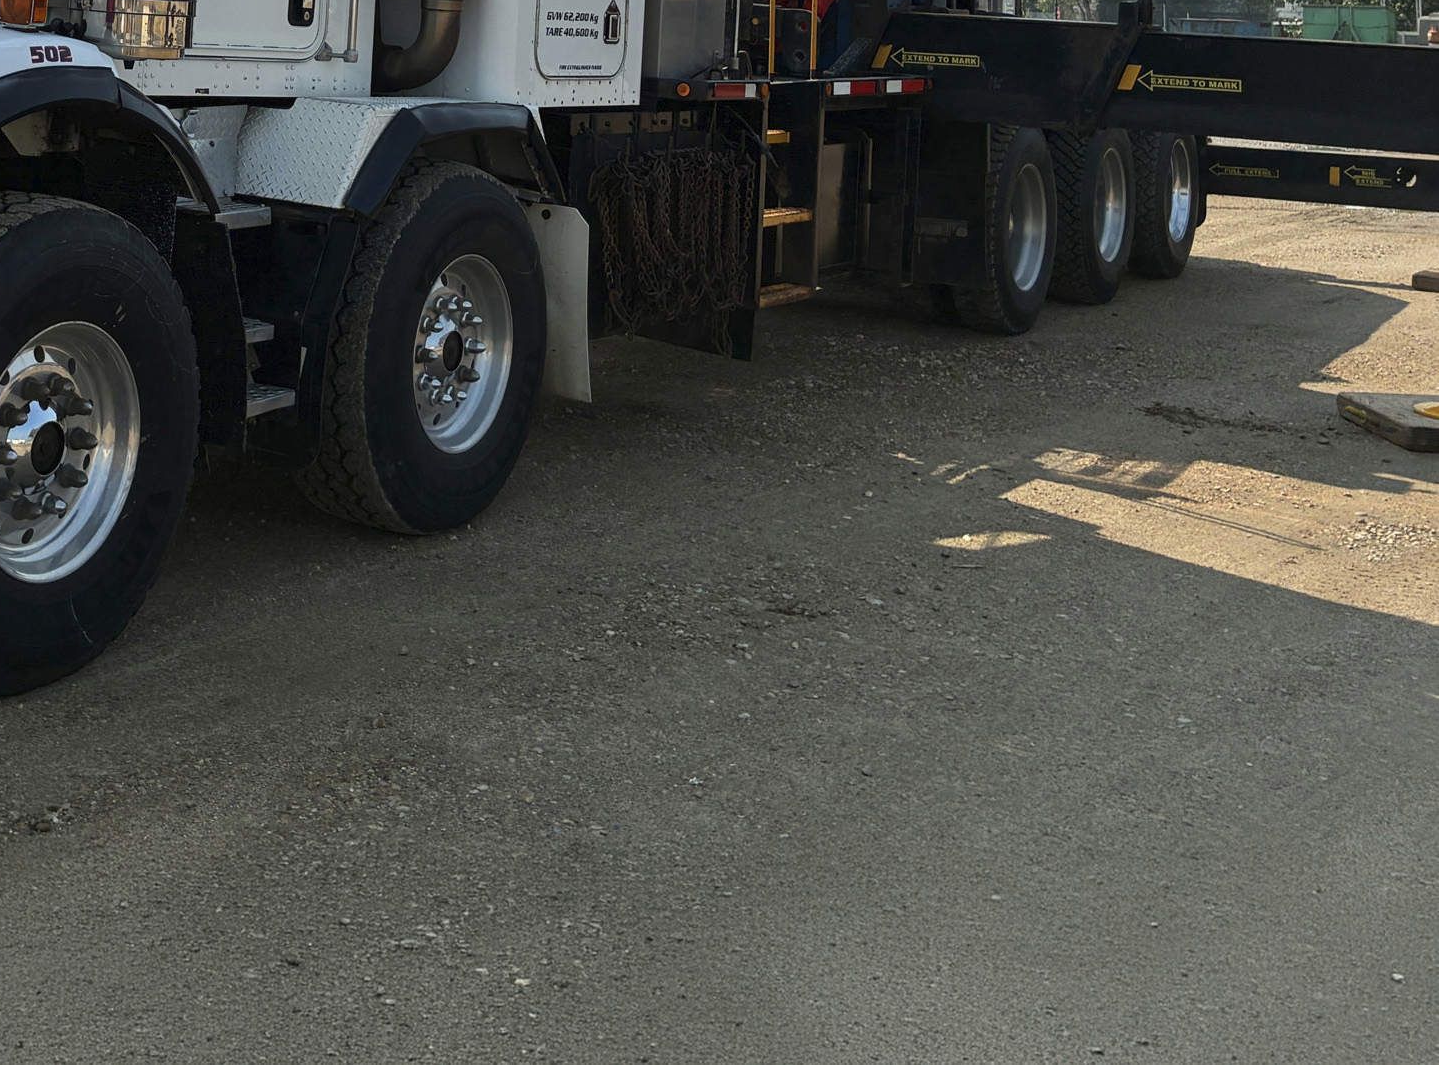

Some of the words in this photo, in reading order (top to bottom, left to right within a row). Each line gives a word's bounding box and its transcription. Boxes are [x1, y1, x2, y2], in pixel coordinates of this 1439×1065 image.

[546, 11, 563, 21] GVW
[564, 12, 589, 22] 62,200
[590, 13, 599, 24] Kg
[546, 27, 563, 37] TARE
[564, 27, 589, 38] 40,600
[590, 28, 599, 39] Kg
[30, 45, 73, 64] 502
[902, 54, 936, 63] EXTEND
[952, 57, 977, 65] MARK
[1151, 77, 1190, 86] EXTEND
[1209, 81, 1238, 89] MARK
